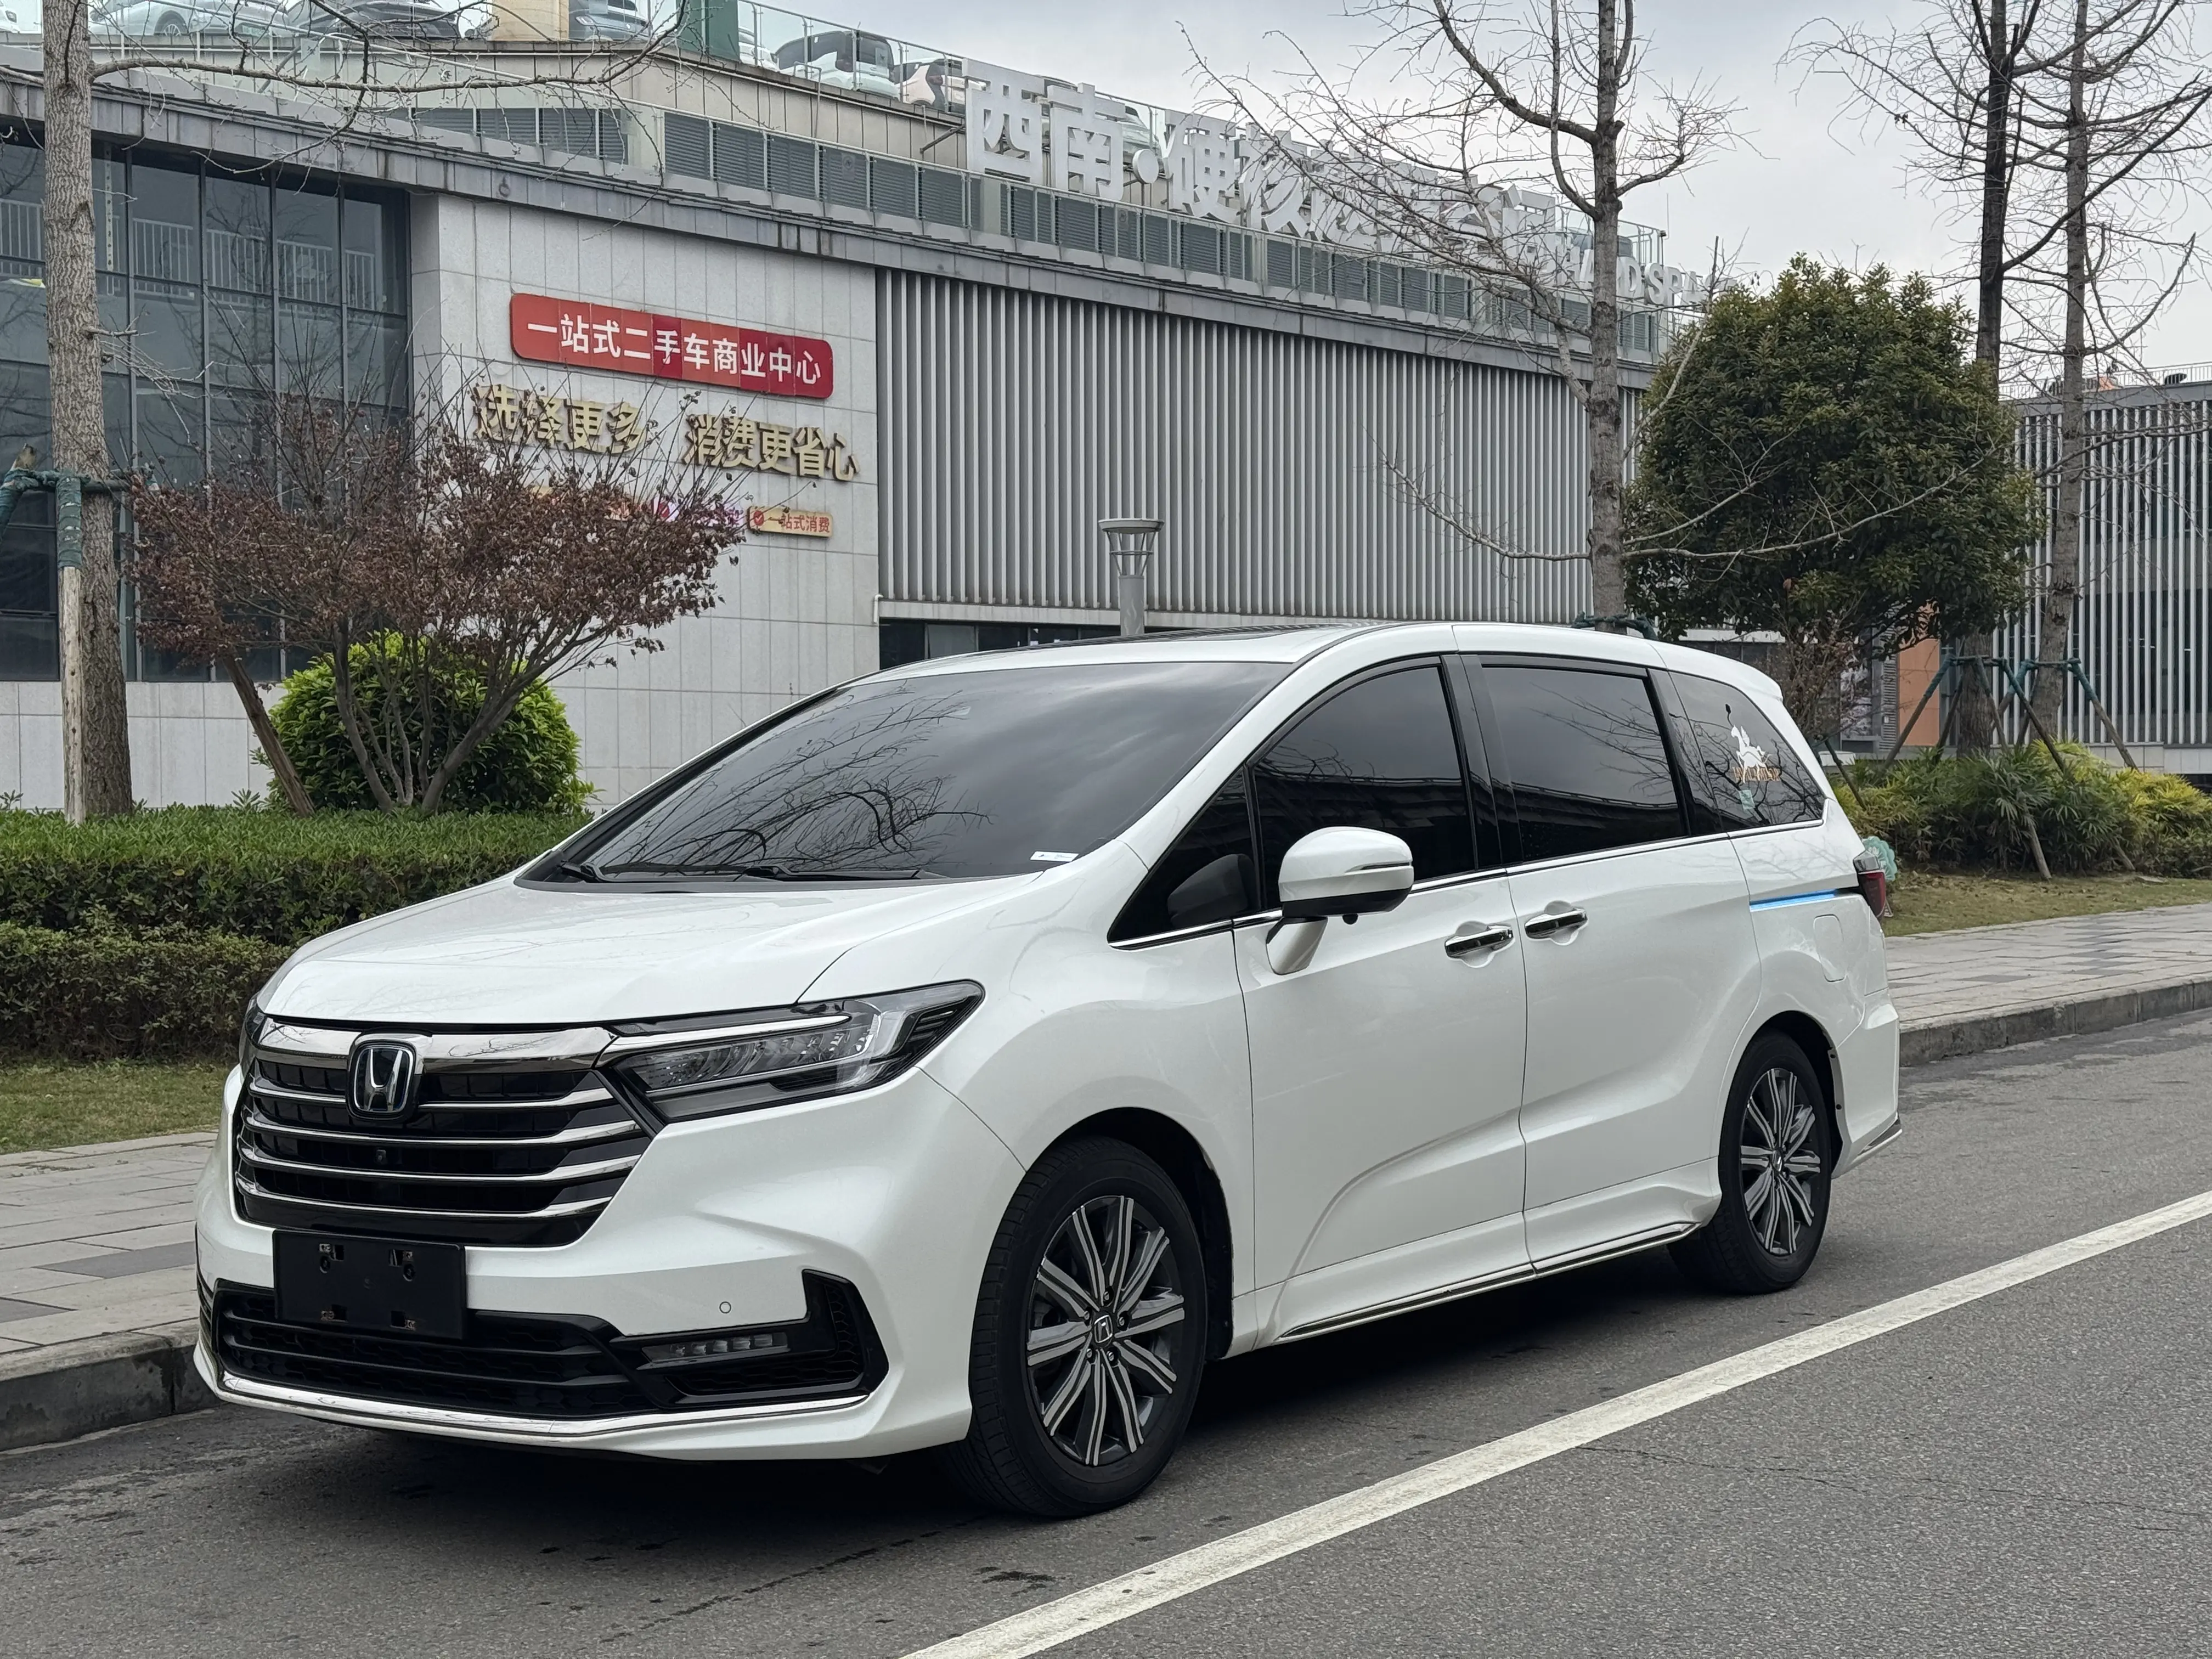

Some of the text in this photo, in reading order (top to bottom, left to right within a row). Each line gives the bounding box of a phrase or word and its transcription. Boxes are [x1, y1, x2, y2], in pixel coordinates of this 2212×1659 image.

[527, 314, 821, 385] 一站式二手车商业中心
[473, 383, 860, 481] 选择更多 消费更省心
[768, 514, 830, 533] 一站式消费
